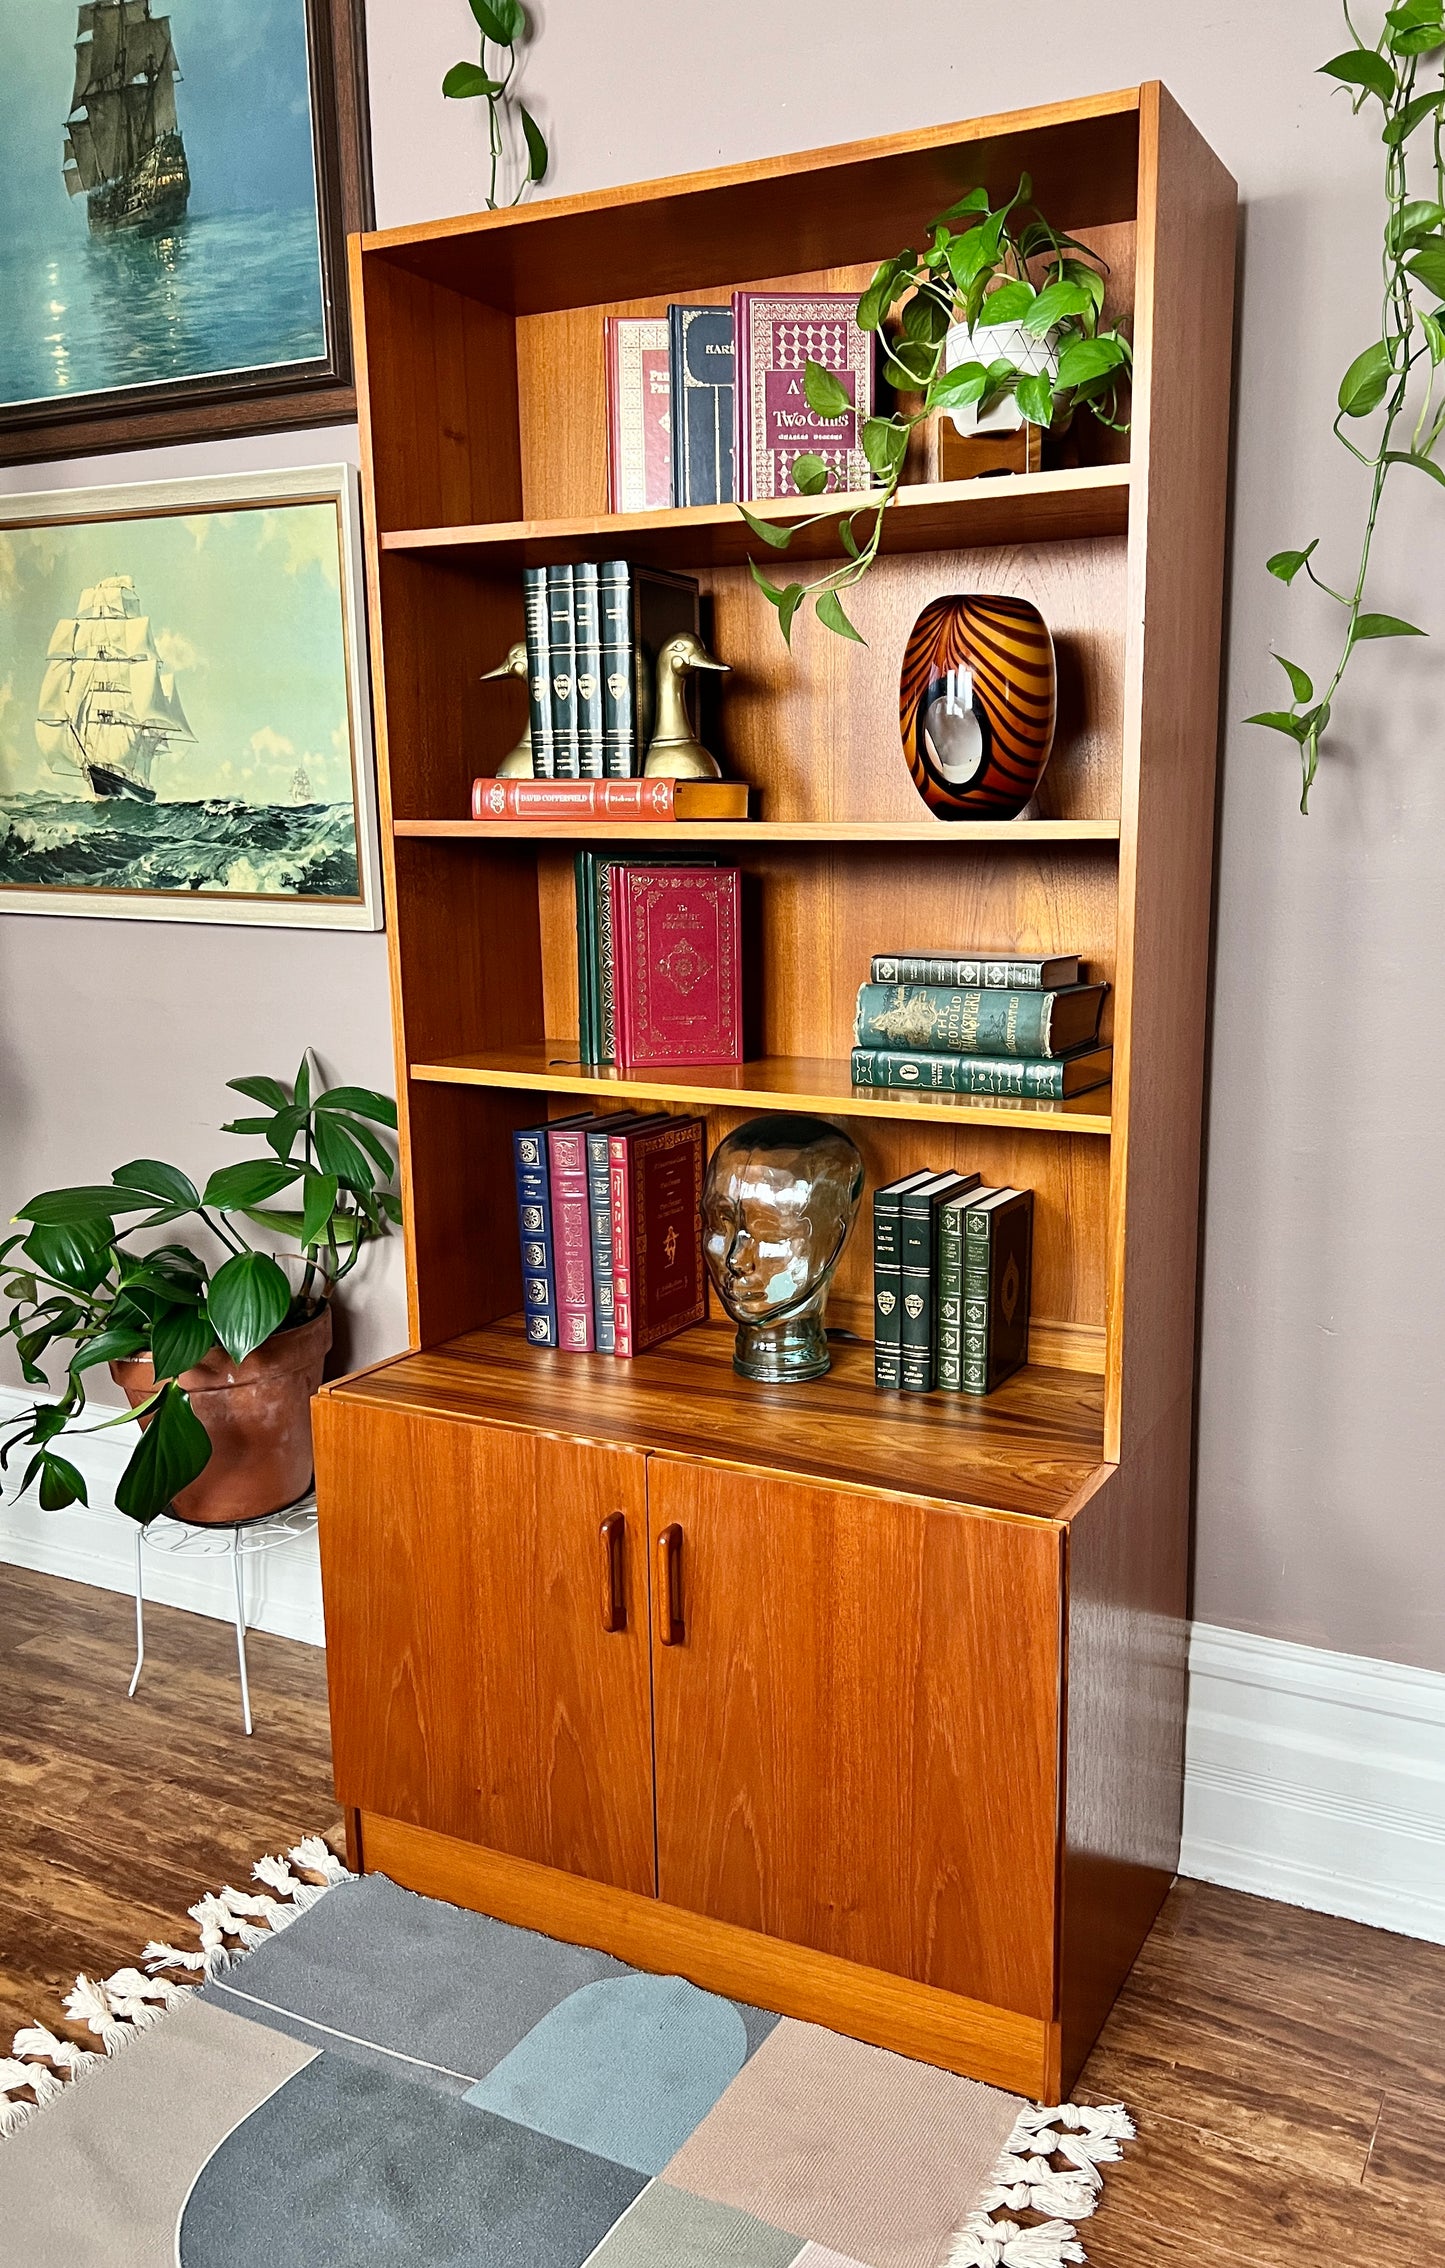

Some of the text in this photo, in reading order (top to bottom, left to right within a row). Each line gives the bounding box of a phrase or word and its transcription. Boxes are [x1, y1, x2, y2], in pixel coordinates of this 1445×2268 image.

[786, 379, 800, 395] A
[520, 794, 588, 803] DAVID COPPERFIELD
[937, 1005, 950, 1039] THE
[947, 995, 962, 1050] LEOPOLD
